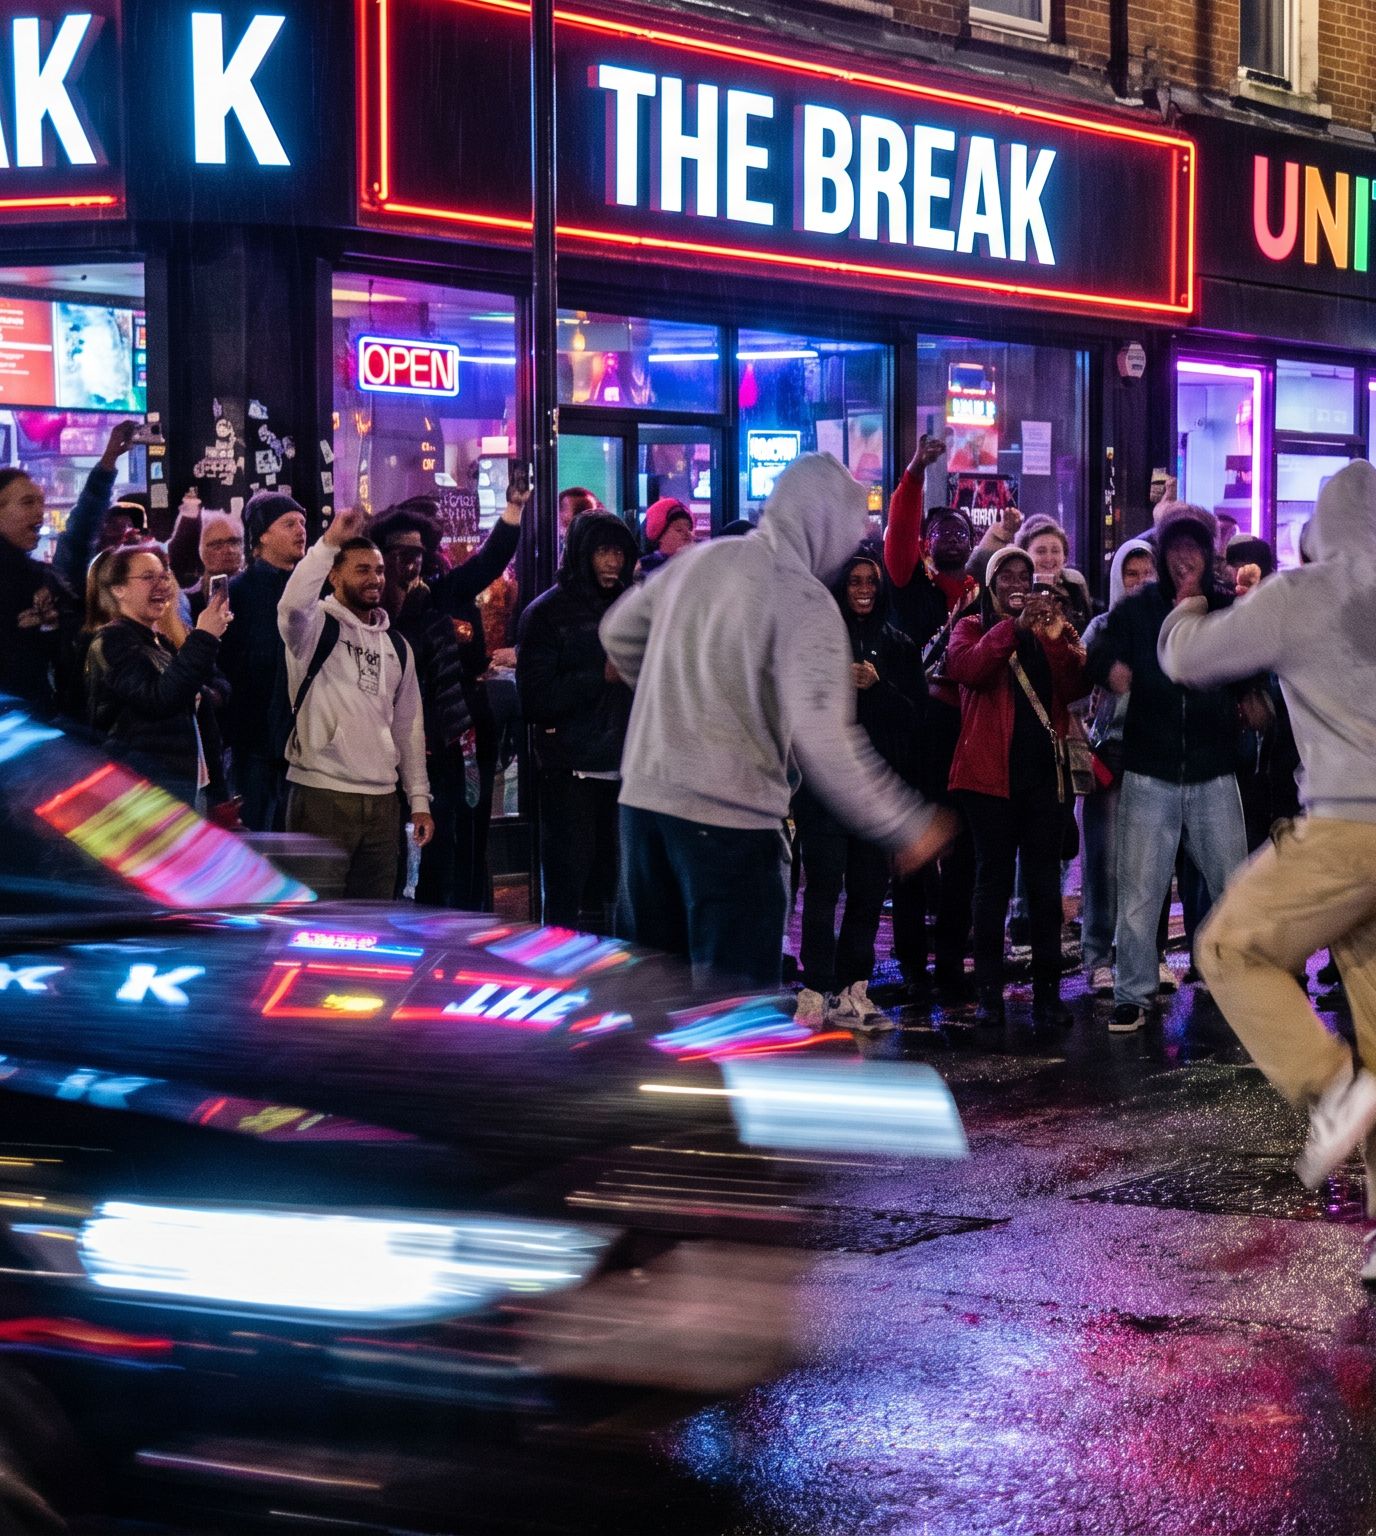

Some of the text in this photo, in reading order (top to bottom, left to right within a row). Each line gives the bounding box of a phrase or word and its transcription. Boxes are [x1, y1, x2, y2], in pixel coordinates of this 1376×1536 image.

[0, 14, 97, 168] K
[191, 12, 291, 166] K
[598, 64, 1056, 266] THE BREAK
[364, 344, 454, 389] OPEN
